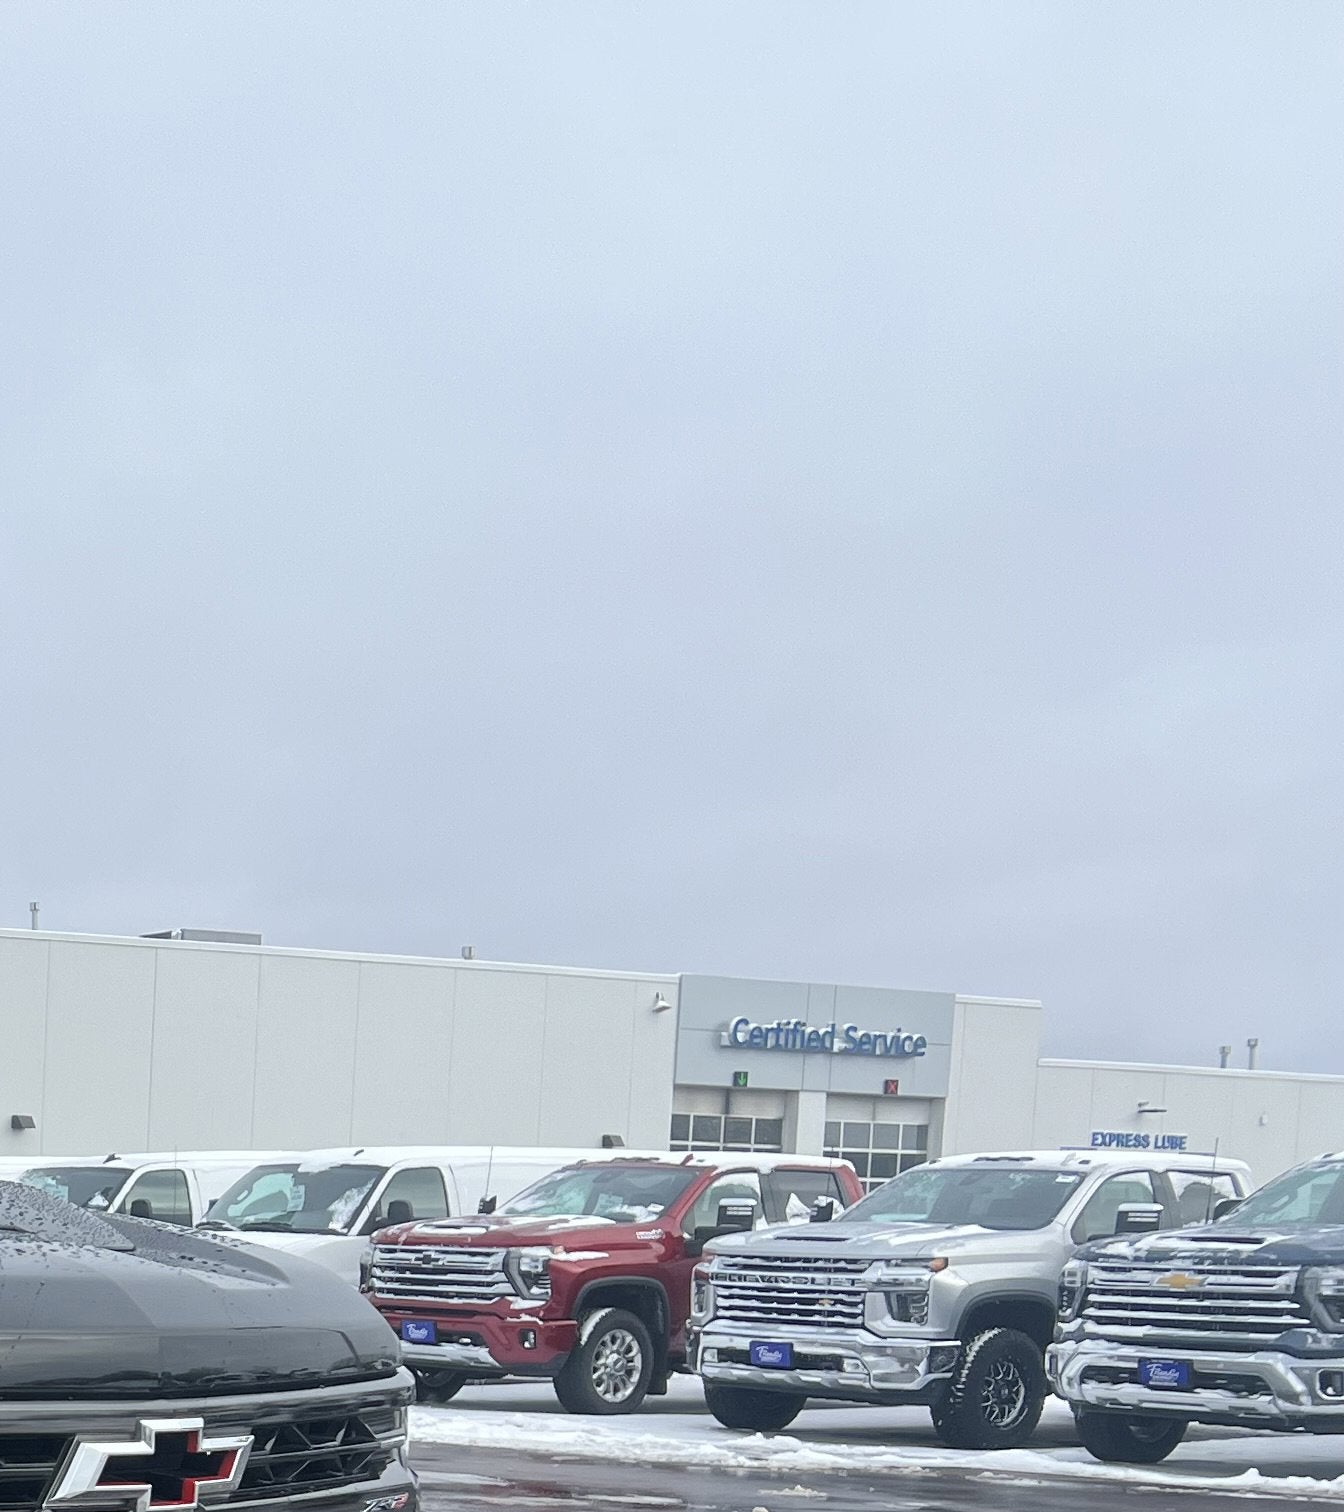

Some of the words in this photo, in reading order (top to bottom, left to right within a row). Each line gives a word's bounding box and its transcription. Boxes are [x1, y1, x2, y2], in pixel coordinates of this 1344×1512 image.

[730, 1016, 836, 1051] Certified
[844, 1024, 928, 1055] Service
[1091, 1131, 1150, 1149] EXPRESS
[1153, 1134, 1188, 1150] LUBE
